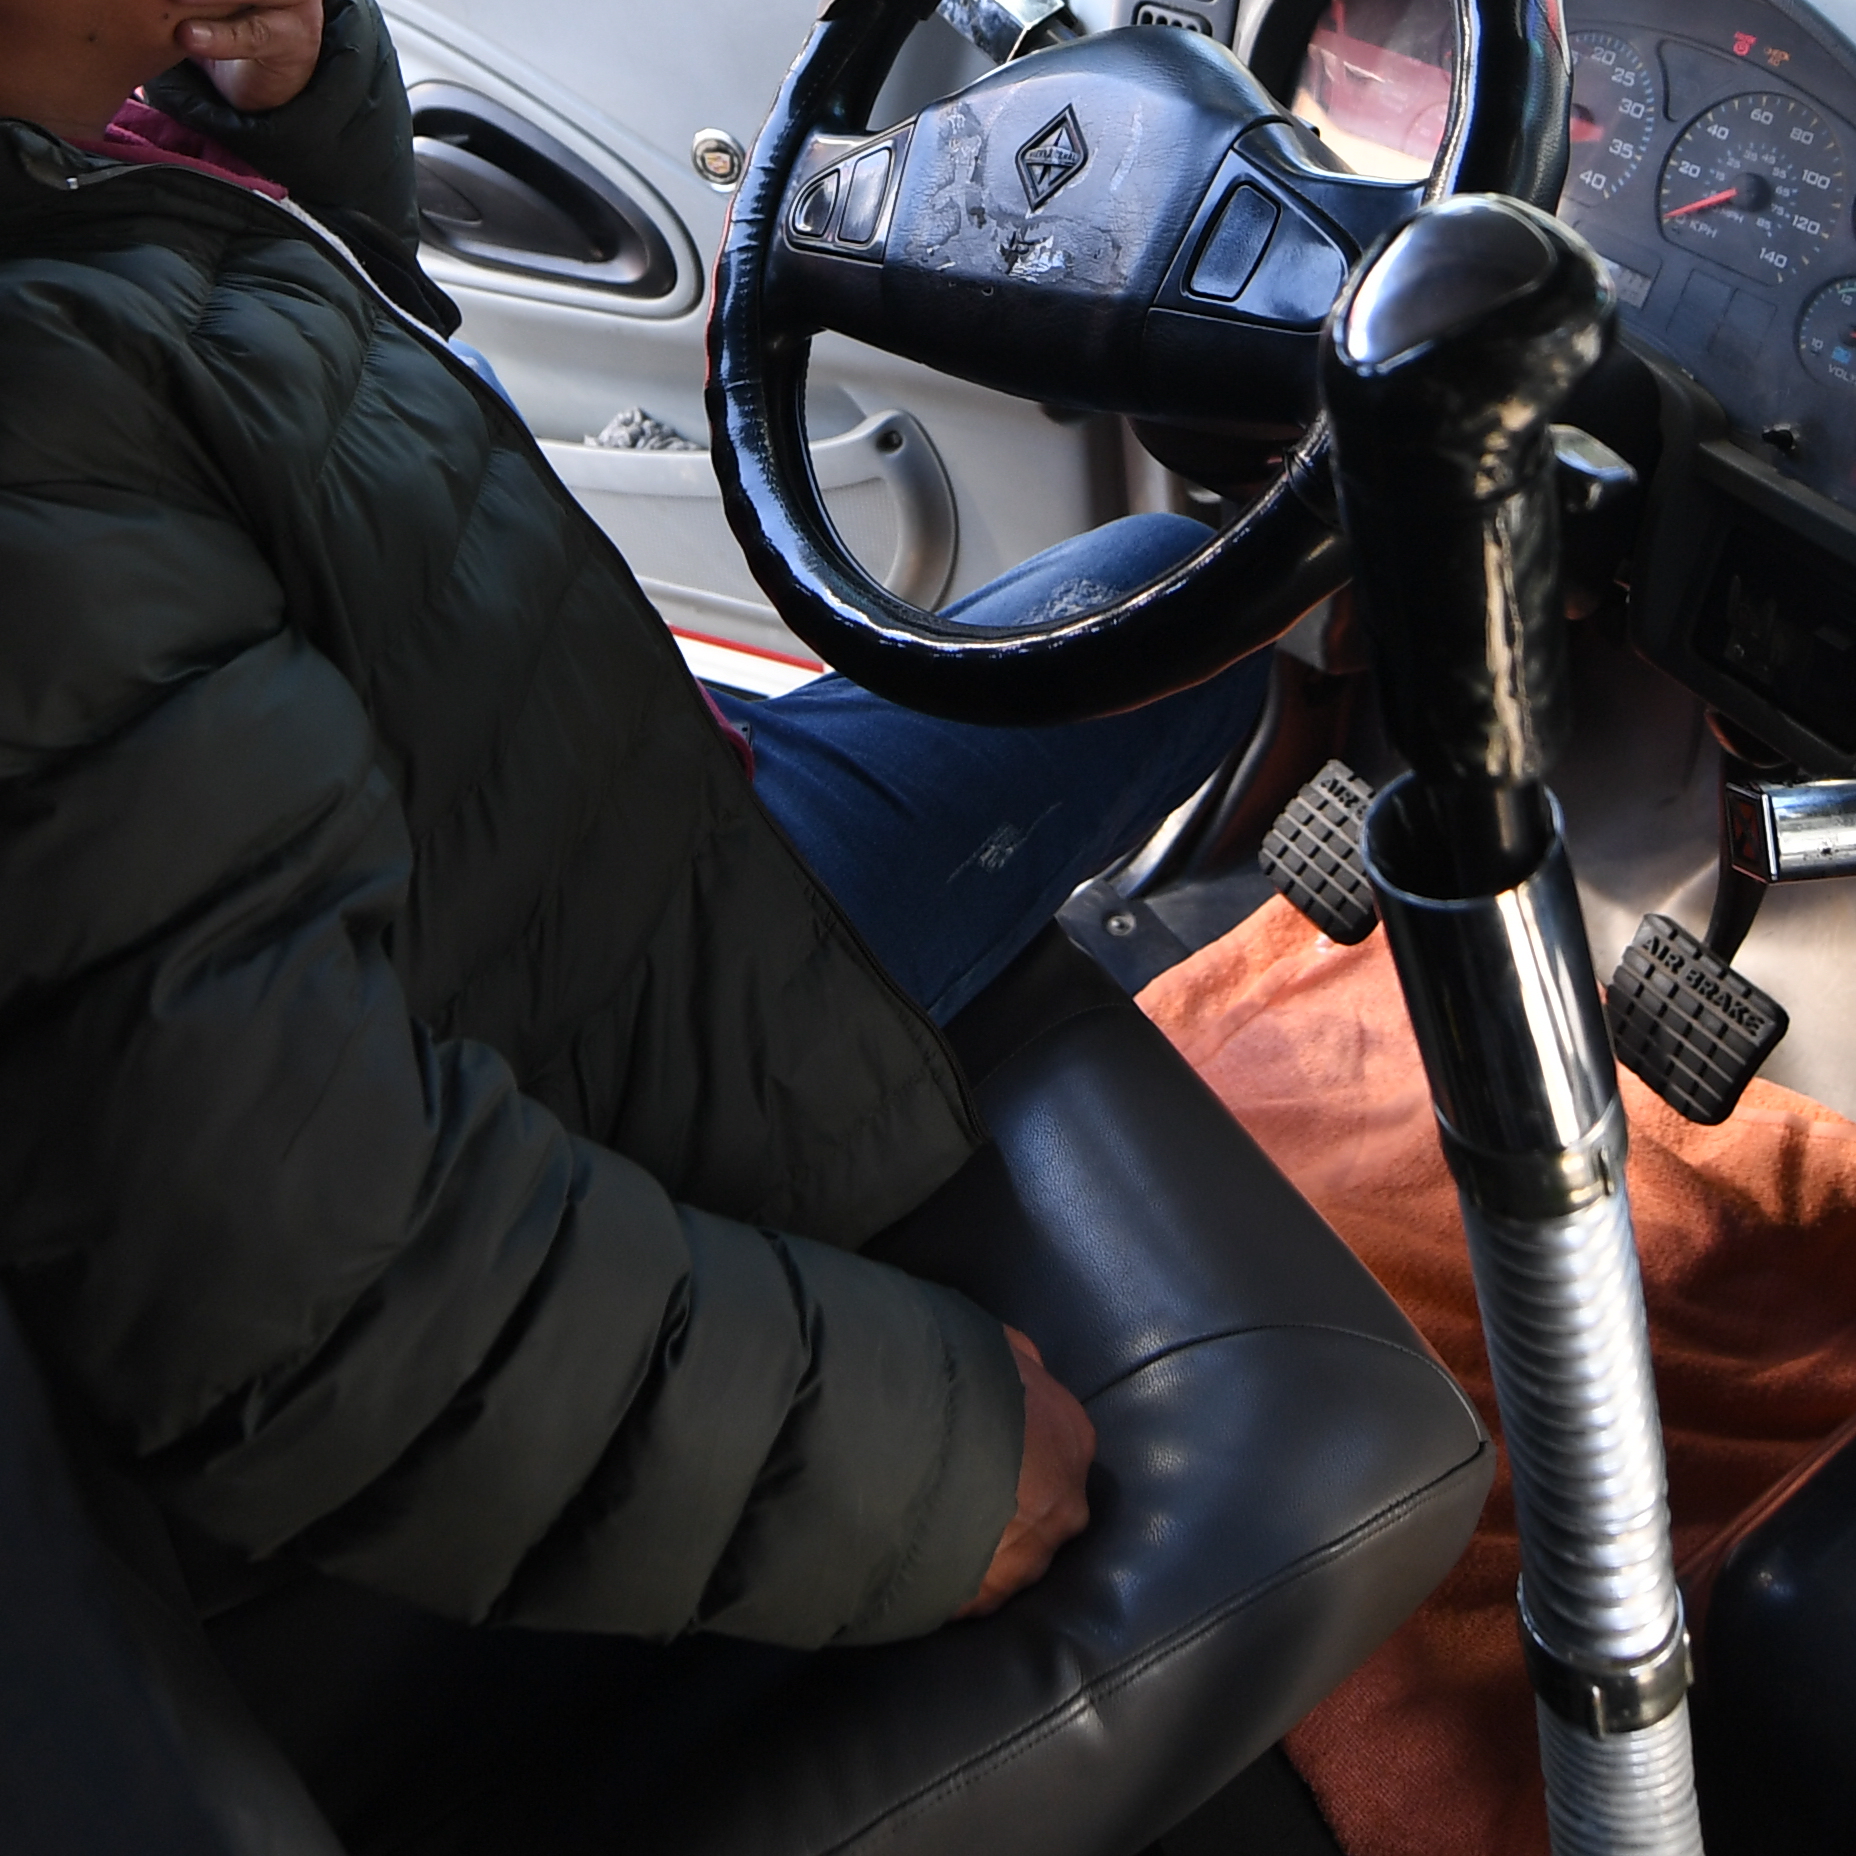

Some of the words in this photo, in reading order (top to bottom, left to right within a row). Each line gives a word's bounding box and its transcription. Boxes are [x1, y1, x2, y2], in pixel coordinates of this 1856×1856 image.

[1591, 47, 1616, 66] 20
[1611, 67, 1636, 87] 25
[1618, 98, 1645, 119] 30
[1750, 108, 1774, 125] 60
[1706, 124, 1729, 140] 40
[1789, 127, 1814, 145] 80
[1609, 138, 1634, 159] 35
[1678, 160, 1701, 178] 20
[1579, 169, 1606, 190] 40
[1801, 169, 1831, 190] 100
[1689, 220, 1718, 239] KPH
[1792, 214, 1821, 235] 120
[1759, 247, 1788, 268] 140
[1811, 337, 1824, 349] 10
